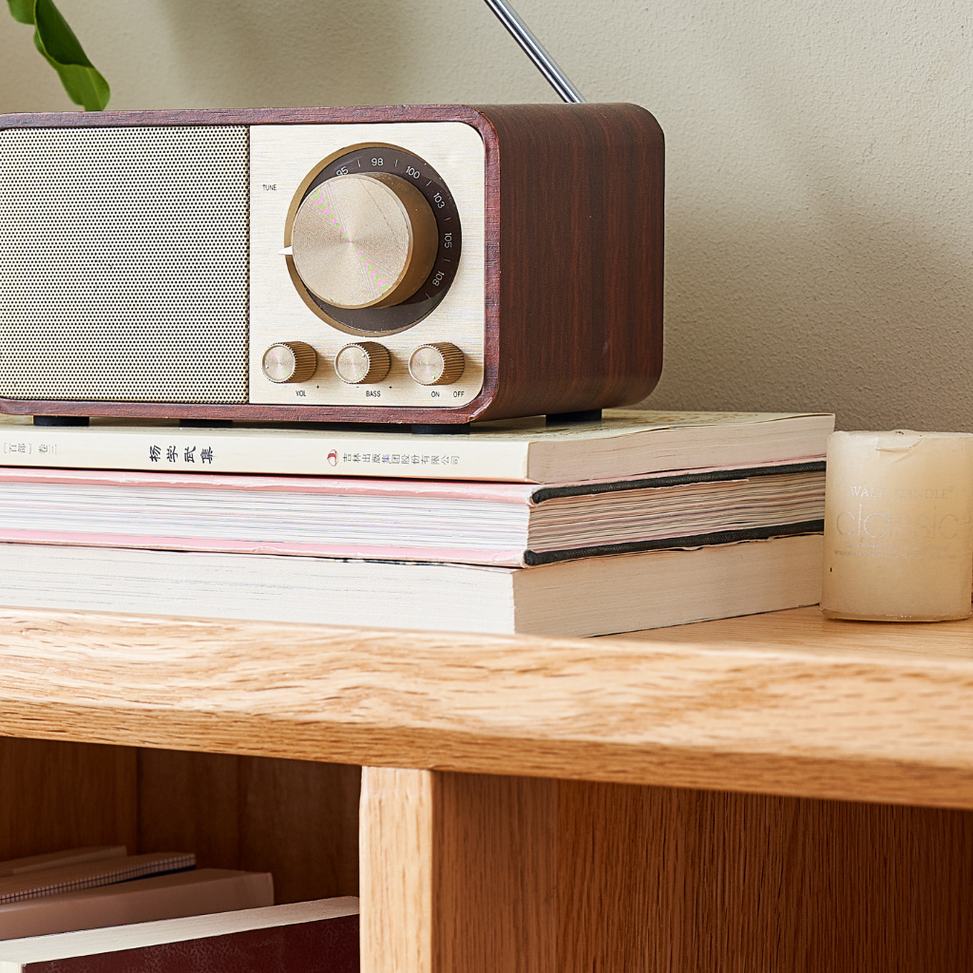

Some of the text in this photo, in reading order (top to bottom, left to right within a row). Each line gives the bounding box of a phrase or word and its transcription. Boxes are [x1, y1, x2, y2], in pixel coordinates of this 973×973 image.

[371, 157, 384, 166] 98
[405, 165, 421, 180] 100
[262, 183, 277, 191] TUNE
[432, 192, 446, 209] 103
[444, 232, 453, 249] 105
[431, 270, 445, 287] 108
[149, 445, 214, 465] 杨学武集
[343, 451, 461, 466] 吉林出版集团股份有限公司
